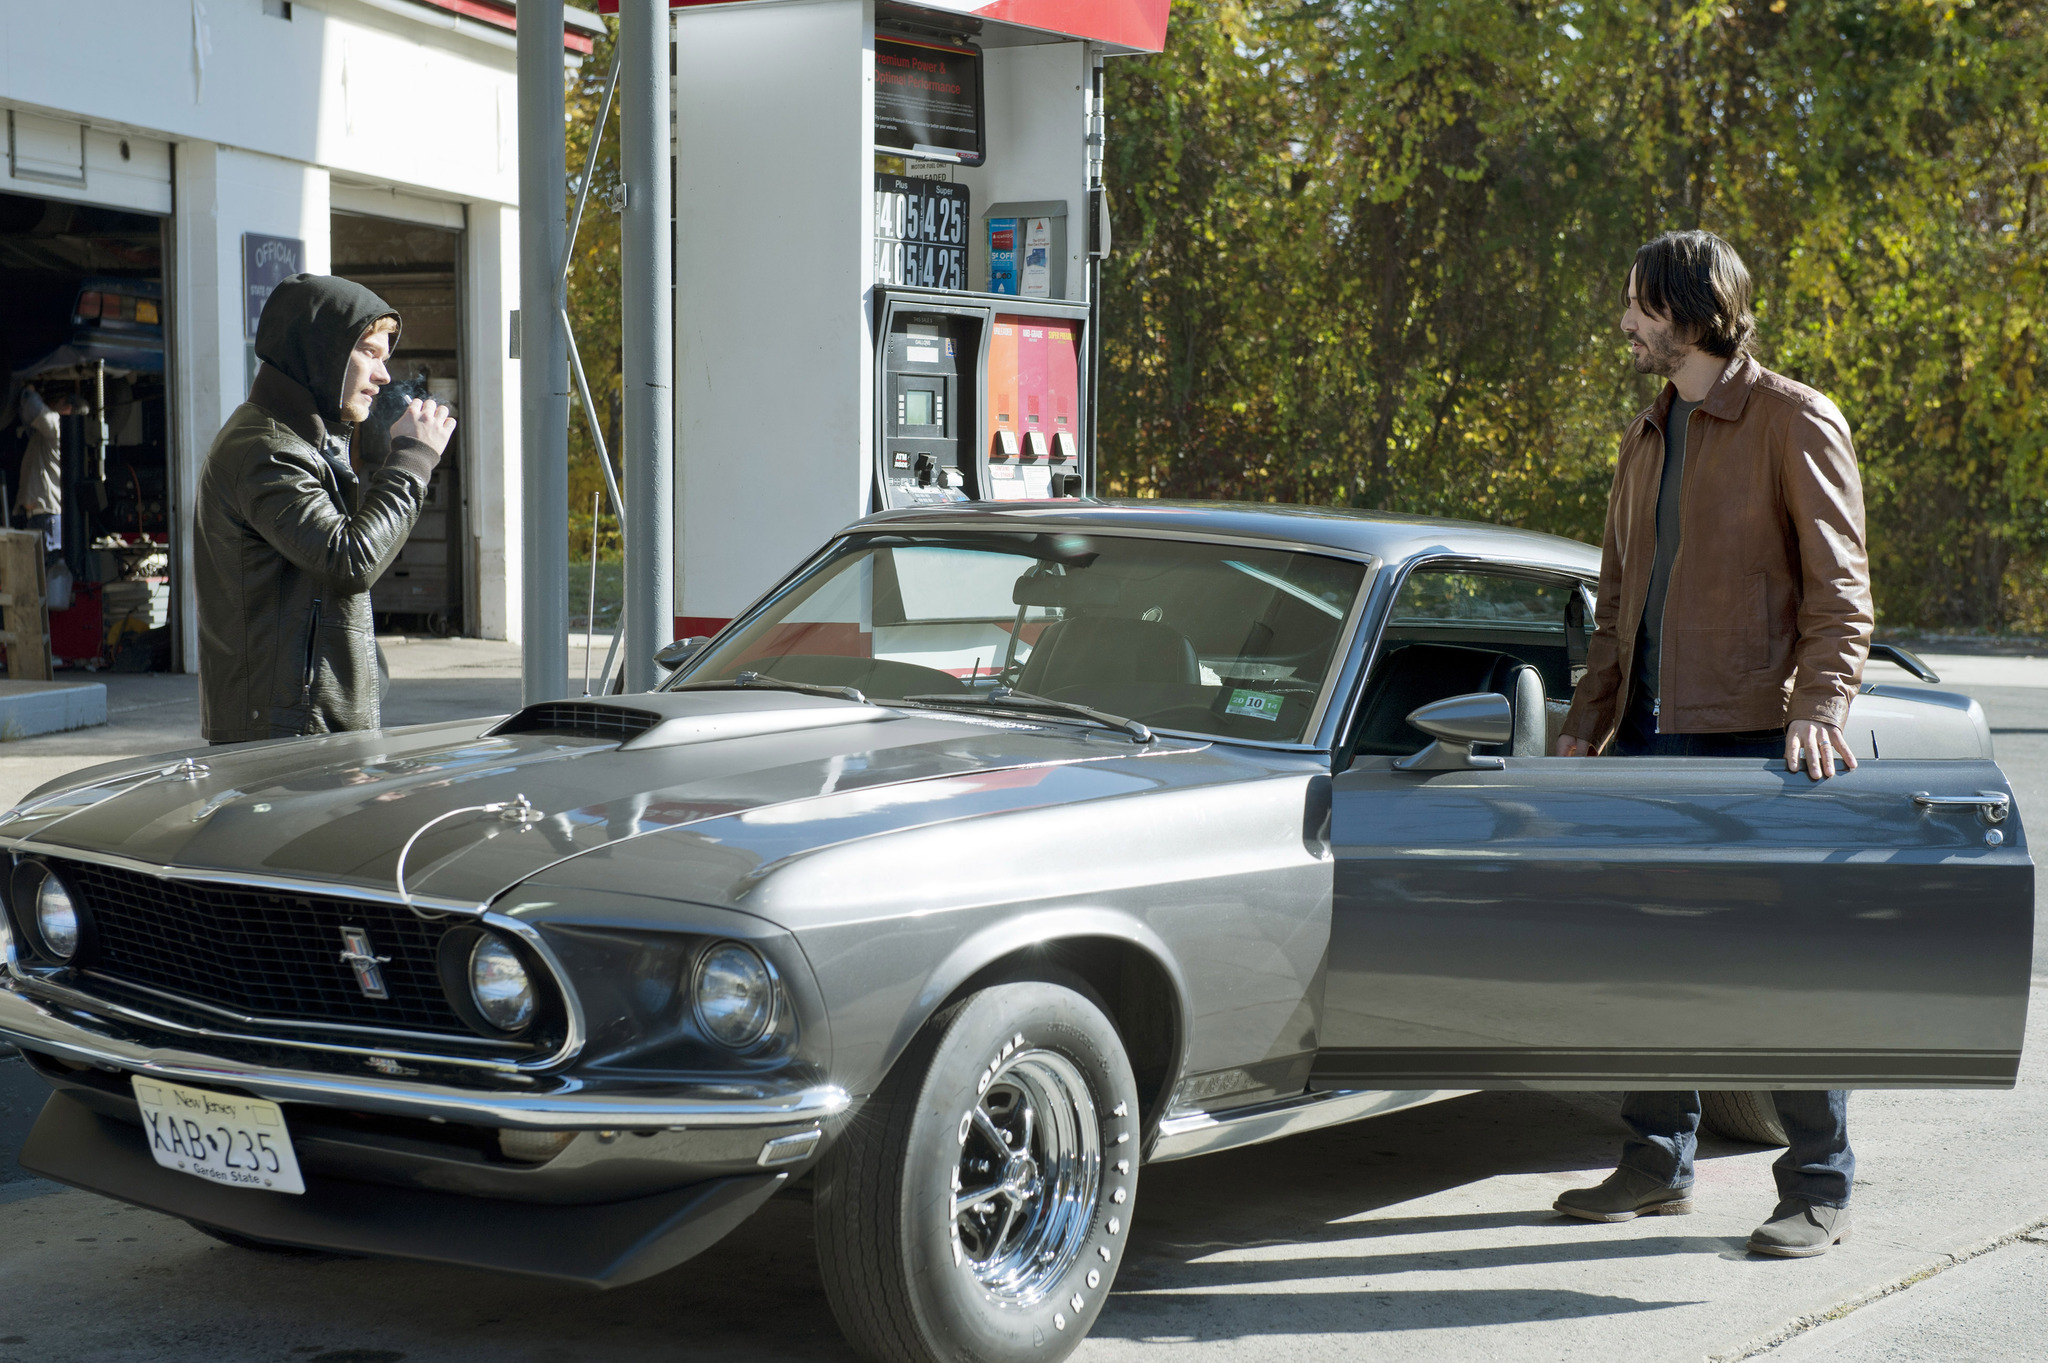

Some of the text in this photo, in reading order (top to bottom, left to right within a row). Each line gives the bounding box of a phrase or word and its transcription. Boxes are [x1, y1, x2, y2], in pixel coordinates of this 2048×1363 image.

[875, 52, 946, 75] Premium Power &
[875, 69, 961, 95] Optimal Performance
[895, 180, 908, 189] Plus
[911, 173, 947, 182] EADED
[935, 185, 954, 196] Super
[924, 197, 962, 244] 4.25
[255, 240, 297, 273] OFFICIAL
[999, 252, 1015, 260] OFF
[923, 247, 961, 290] 425
[250, 284, 265, 296] STATE
[896, 452, 908, 460] ATM
[1232, 696, 1278, 710] 20 10 14
[173, 1089, 237, 1119] New Jersey
[193, 1163, 260, 1184] Garden State
